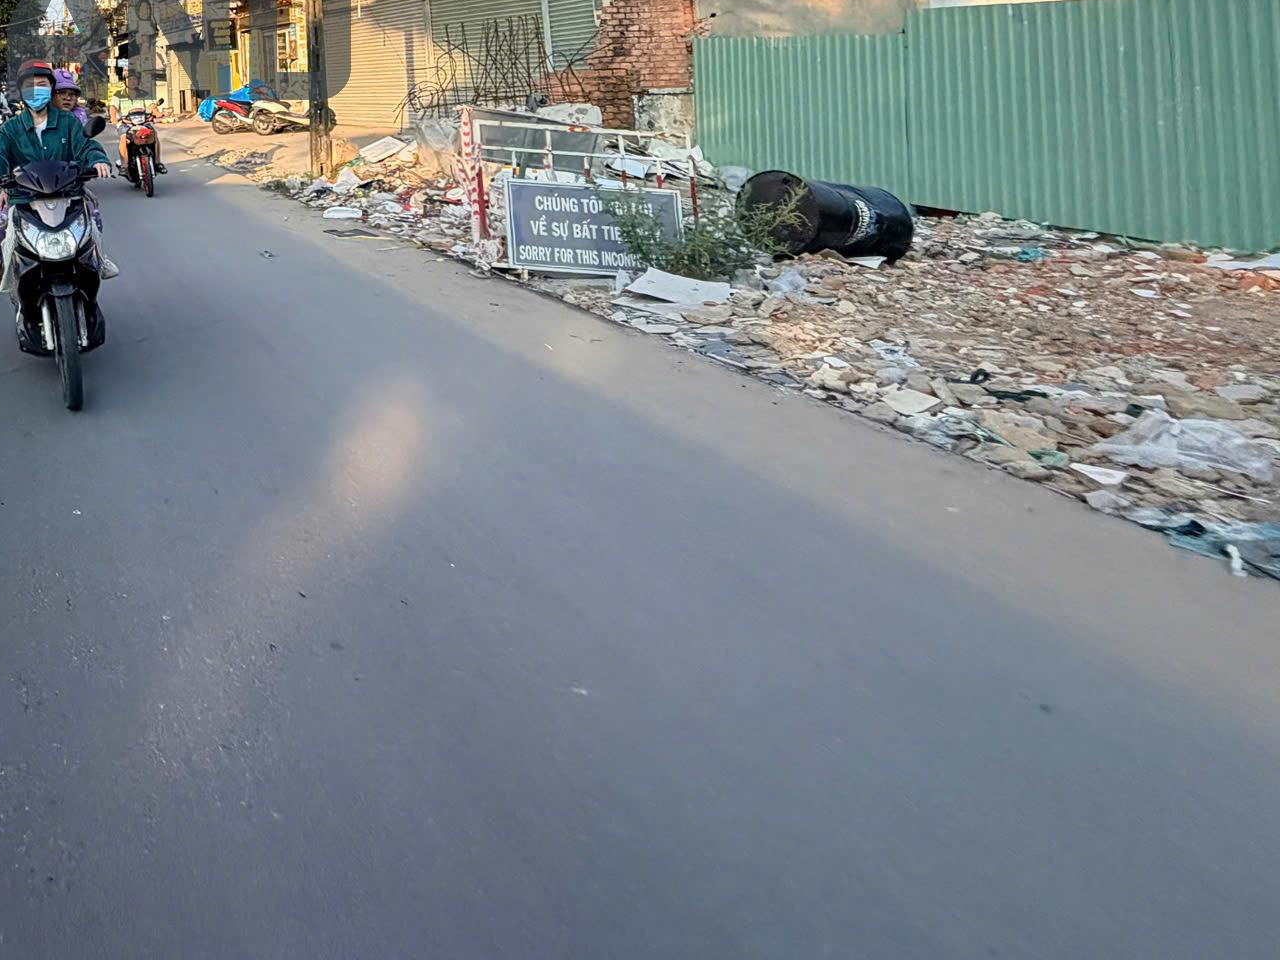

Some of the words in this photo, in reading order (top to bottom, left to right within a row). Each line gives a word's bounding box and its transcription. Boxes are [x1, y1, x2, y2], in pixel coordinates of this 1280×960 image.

[534, 193, 579, 213] CHÚNG
[580, 195, 603, 214] TÔI
[529, 214, 549, 236] VỀ
[551, 220, 569, 241] SỰ
[572, 218, 598, 240] BẤT
[519, 244, 552, 262] SORRY
[554, 247, 574, 264] FOR
[576, 249, 600, 266] THIS
